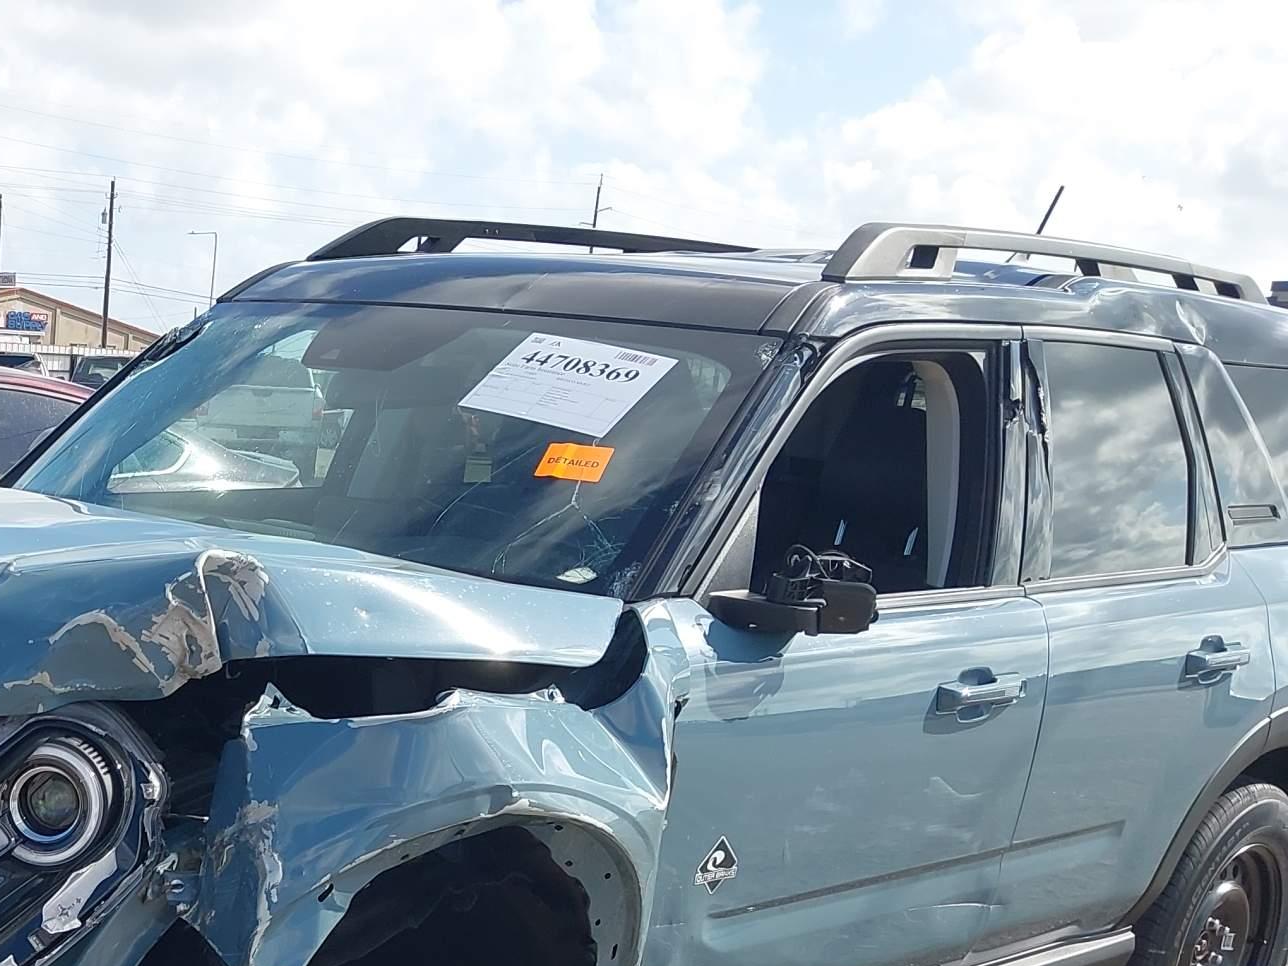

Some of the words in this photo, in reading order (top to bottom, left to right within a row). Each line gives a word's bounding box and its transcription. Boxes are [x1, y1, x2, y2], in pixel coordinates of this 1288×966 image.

[31, 313, 47, 321] AND
[521, 350, 641, 383] 44708369
[547, 456, 600, 469] DETAILED
